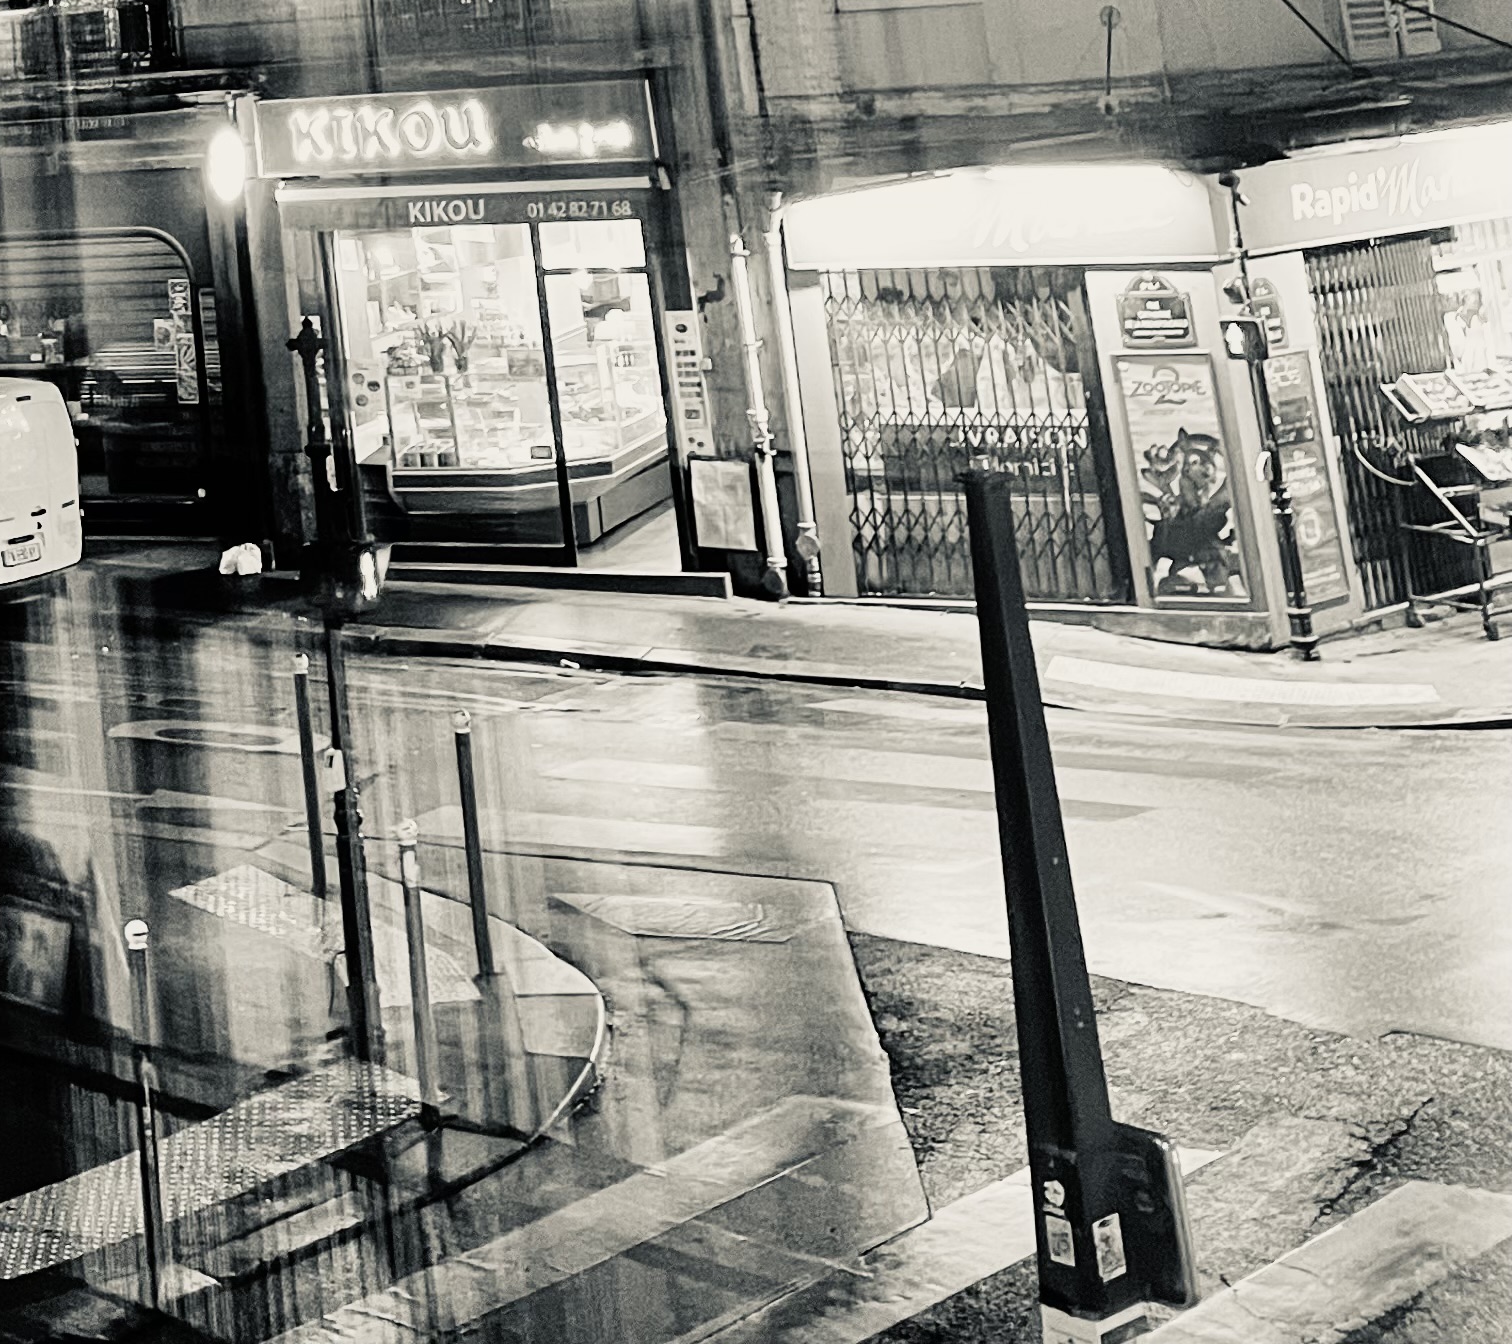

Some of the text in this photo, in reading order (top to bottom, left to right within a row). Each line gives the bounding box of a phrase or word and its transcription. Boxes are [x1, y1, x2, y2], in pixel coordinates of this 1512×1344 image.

[290, 99, 490, 161] KIKOU
[407, 198, 485, 223] KIKOU
[527, 202, 544, 218] 01
[548, 201, 567, 218] 42
[590, 200, 608, 216] 71
[611, 200, 632, 216] 68
